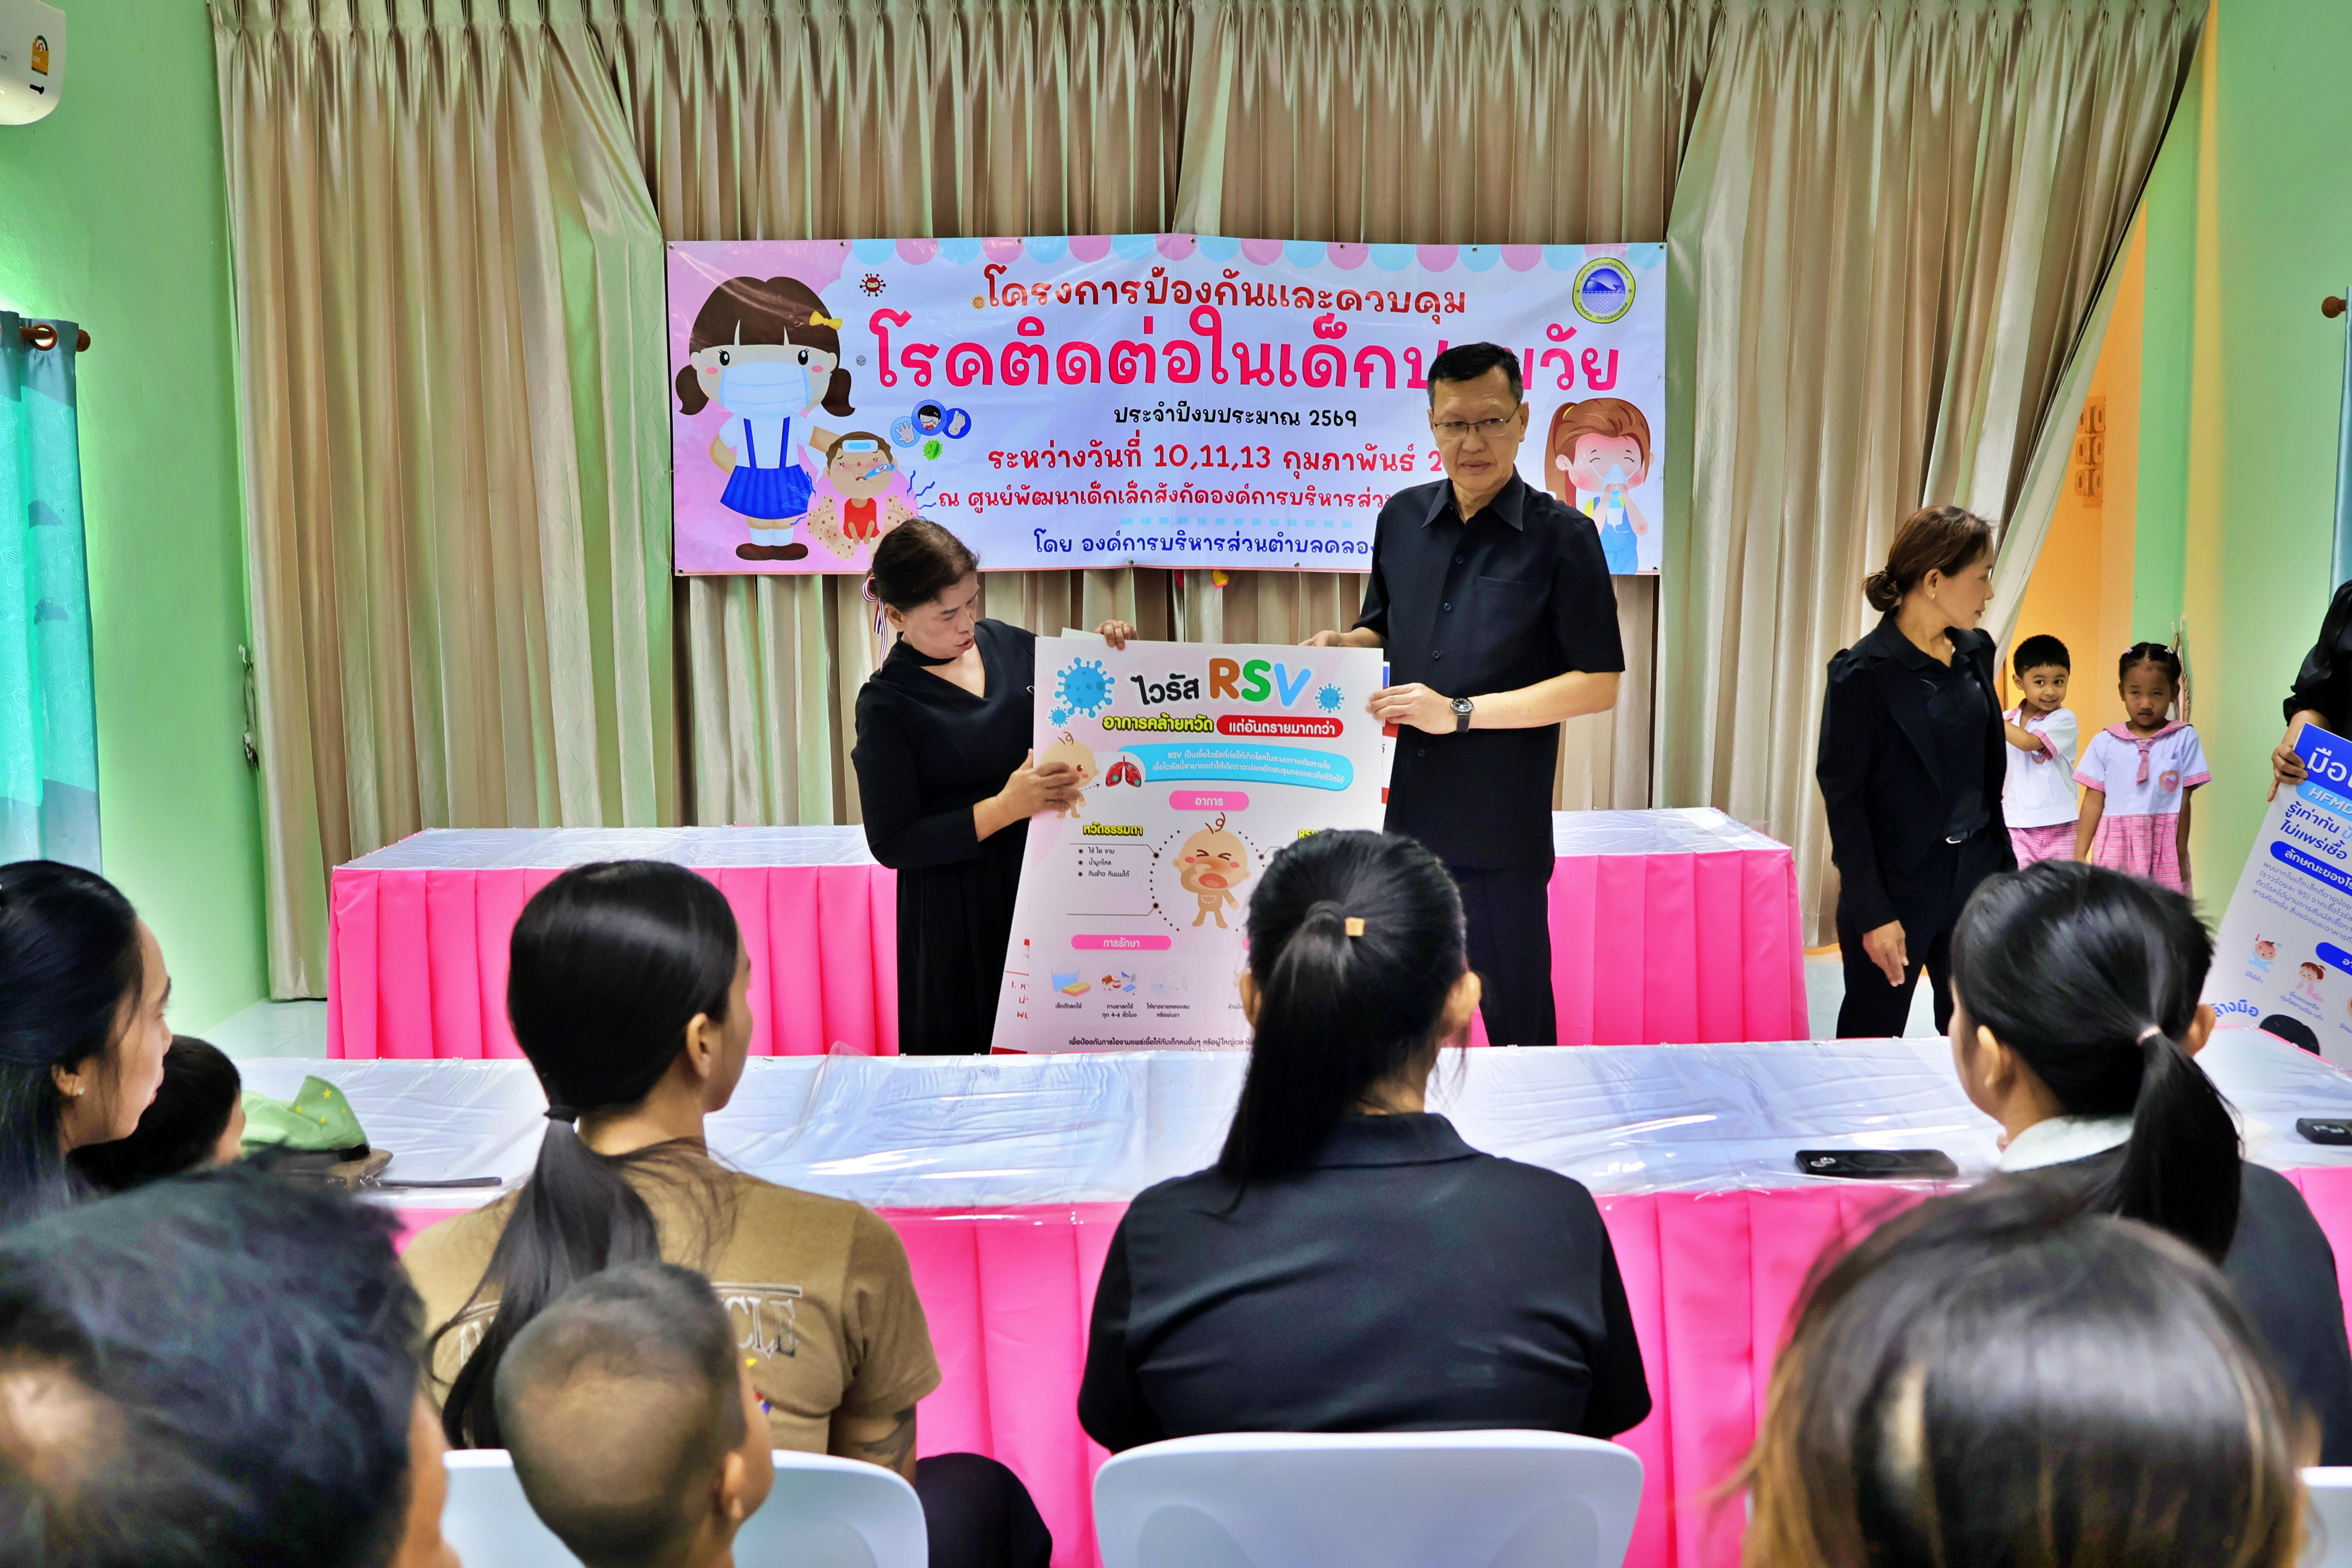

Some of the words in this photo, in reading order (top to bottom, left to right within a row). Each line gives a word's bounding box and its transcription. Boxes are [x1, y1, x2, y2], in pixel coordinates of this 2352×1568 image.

[984, 264, 1465, 325] โครงการป้องกันและควบคุม
[869, 305, 1619, 391] โรคติดต่อในเด็กปวัย
[1114, 401, 1300, 426] ประจำปีงบประมาณ
[1309, 410, 1356, 426] 2569
[988, 430, 1142, 469] ระหว่างวันที่
[1153, 444, 1270, 471] 10,11,13
[1283, 443, 1415, 479] กุมภาพันธ์
[939, 492, 960, 506] ณ
[1034, 528, 1072, 552] โดย
[1131, 673, 1199, 705] ไวรัส
[1209, 658, 1311, 706] RSV
[1103, 713, 1214, 732] อาการคล้ายหวัด
[1229, 720, 1335, 735] แต่อันตรายมากกว่า
[1195, 797, 1223, 806] อาการ
[1083, 821, 1143, 836] หวัดธรรมดา
[2285, 801, 2340, 833] รู้เท่าทัน
[2280, 819, 2347, 860] ไม่แพร่เชื้อ
[1103, 937, 1140, 948] การรักษา
